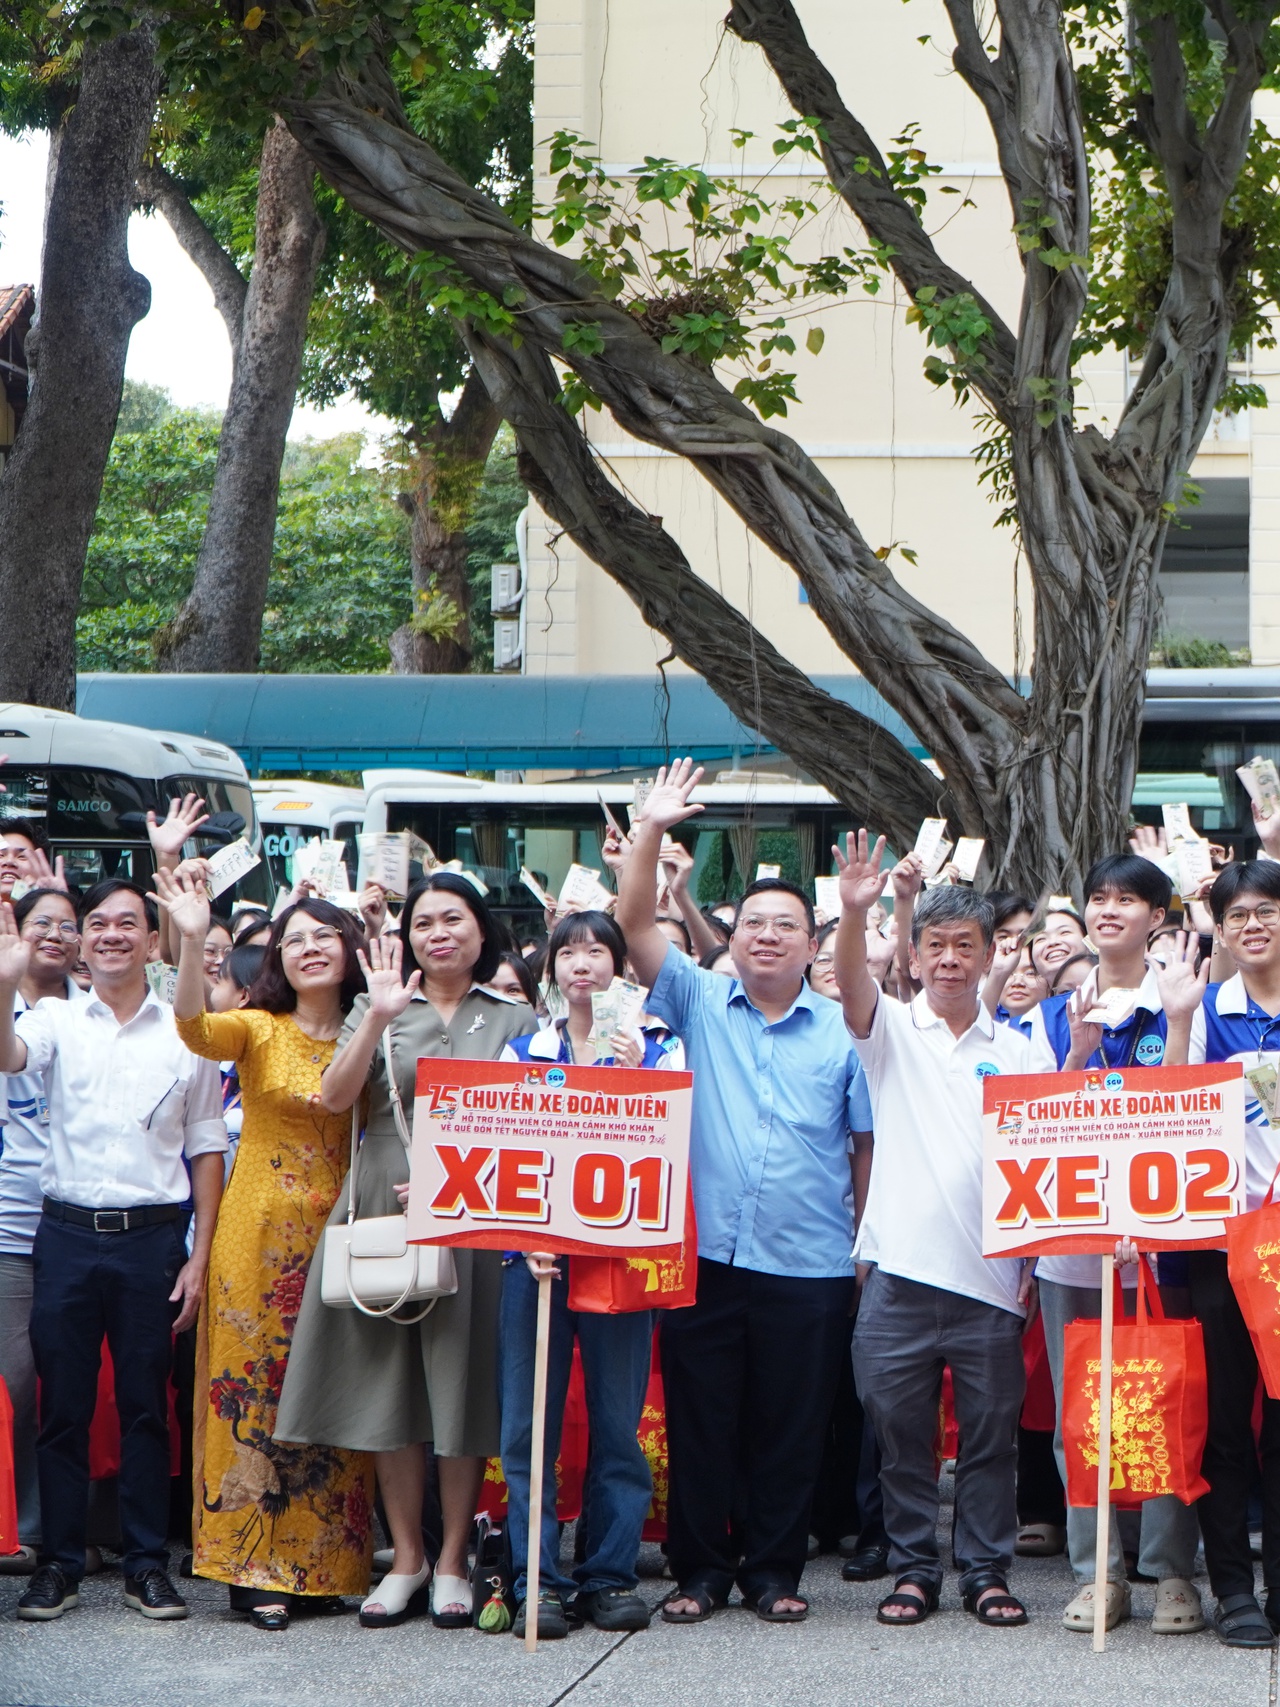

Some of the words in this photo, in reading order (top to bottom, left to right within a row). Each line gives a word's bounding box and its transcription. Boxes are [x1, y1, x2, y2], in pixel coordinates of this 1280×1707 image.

[57, 799, 112, 812] SAMCO
[1139, 1045, 1162, 1054] SGU
[462, 1081, 535, 1111] CHUYẾN
[538, 1094, 562, 1113] XE
[566, 1090, 620, 1116] ĐOÀN
[623, 1094, 668, 1118] VIÊN
[1027, 1091, 1094, 1121] CHUYẾN
[1100, 1098, 1122, 1117] XE
[1126, 1090, 1175, 1115] ĐOÀN
[1180, 1088, 1221, 1112] VIÊN
[519, 1116, 539, 1125] VIÊN
[542, 1117, 552, 1126] CÓ
[555, 1118, 580, 1128] HOÀN
[608, 1121, 626, 1130] KHÓ
[1082, 1122, 1101, 1131] VIÊN
[1104, 1121, 1113, 1130] CÓ
[1116, 1120, 1139, 1129] HOÀN
[1167, 1118, 1184, 1127] KHÓ
[454, 1123, 471, 1132] QUÊ
[513, 1126, 548, 1136] NGUYÊN
[576, 1130, 601, 1139] XUÂN
[1021, 1135, 1037, 1144] QUÊ
[1077, 1132, 1110, 1141] NGUYÊN
[1138, 1129, 1161, 1138] XUÂN
[428, 1143, 548, 1220] XE
[571, 1152, 667, 1228] 01
[993, 1155, 1104, 1226] XE
[1127, 1148, 1236, 1221] 02
